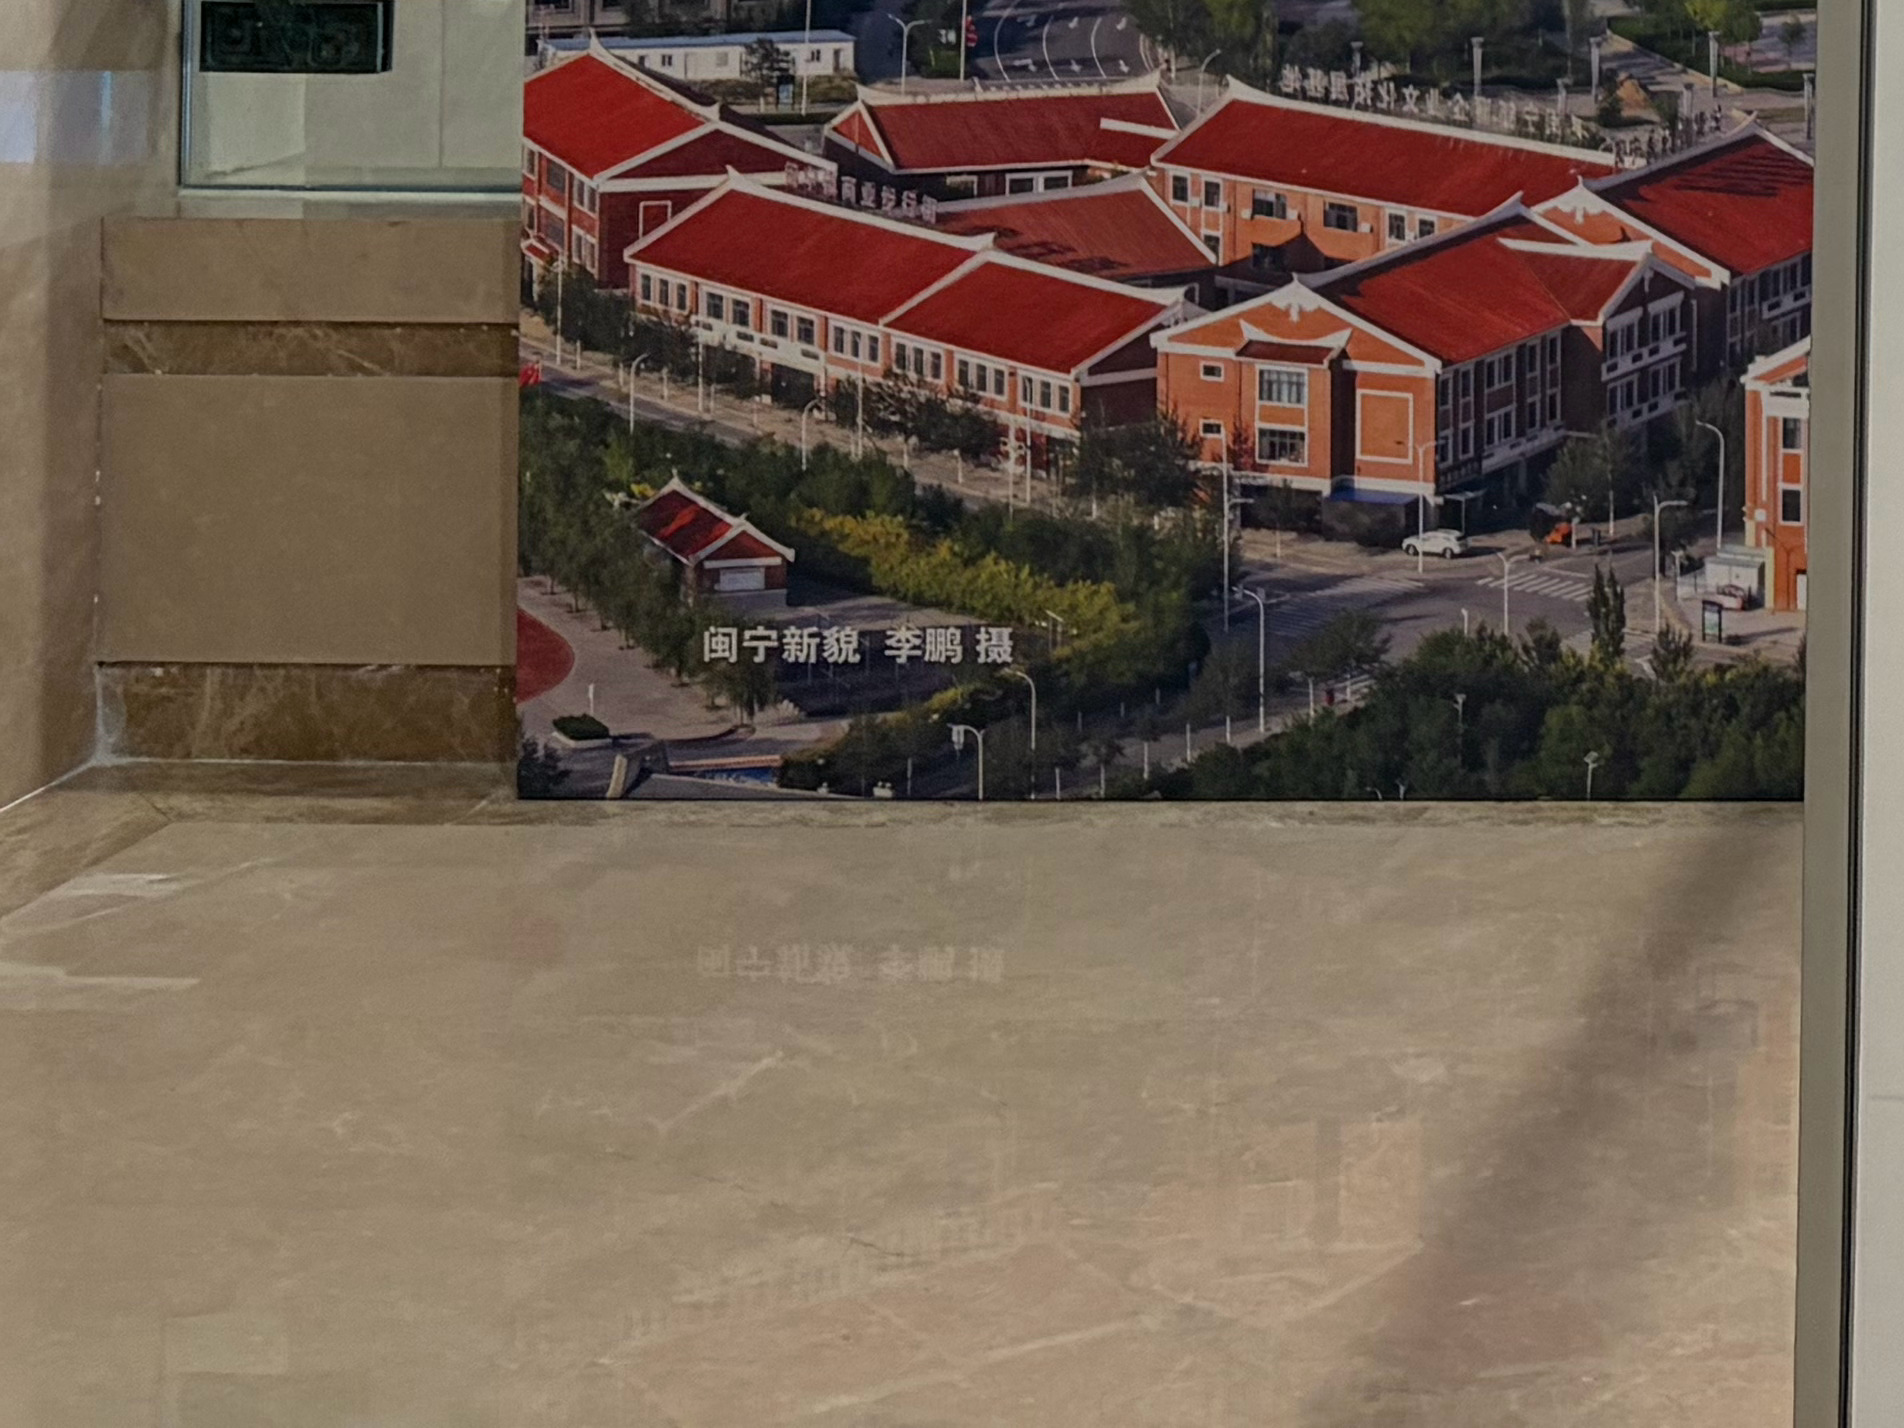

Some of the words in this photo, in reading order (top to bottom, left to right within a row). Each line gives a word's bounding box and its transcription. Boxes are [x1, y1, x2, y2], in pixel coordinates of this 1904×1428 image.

[703, 625, 861, 665] 闽宁新貌
[884, 623, 962, 665] 李鹏
[975, 626, 1014, 665] 摄
